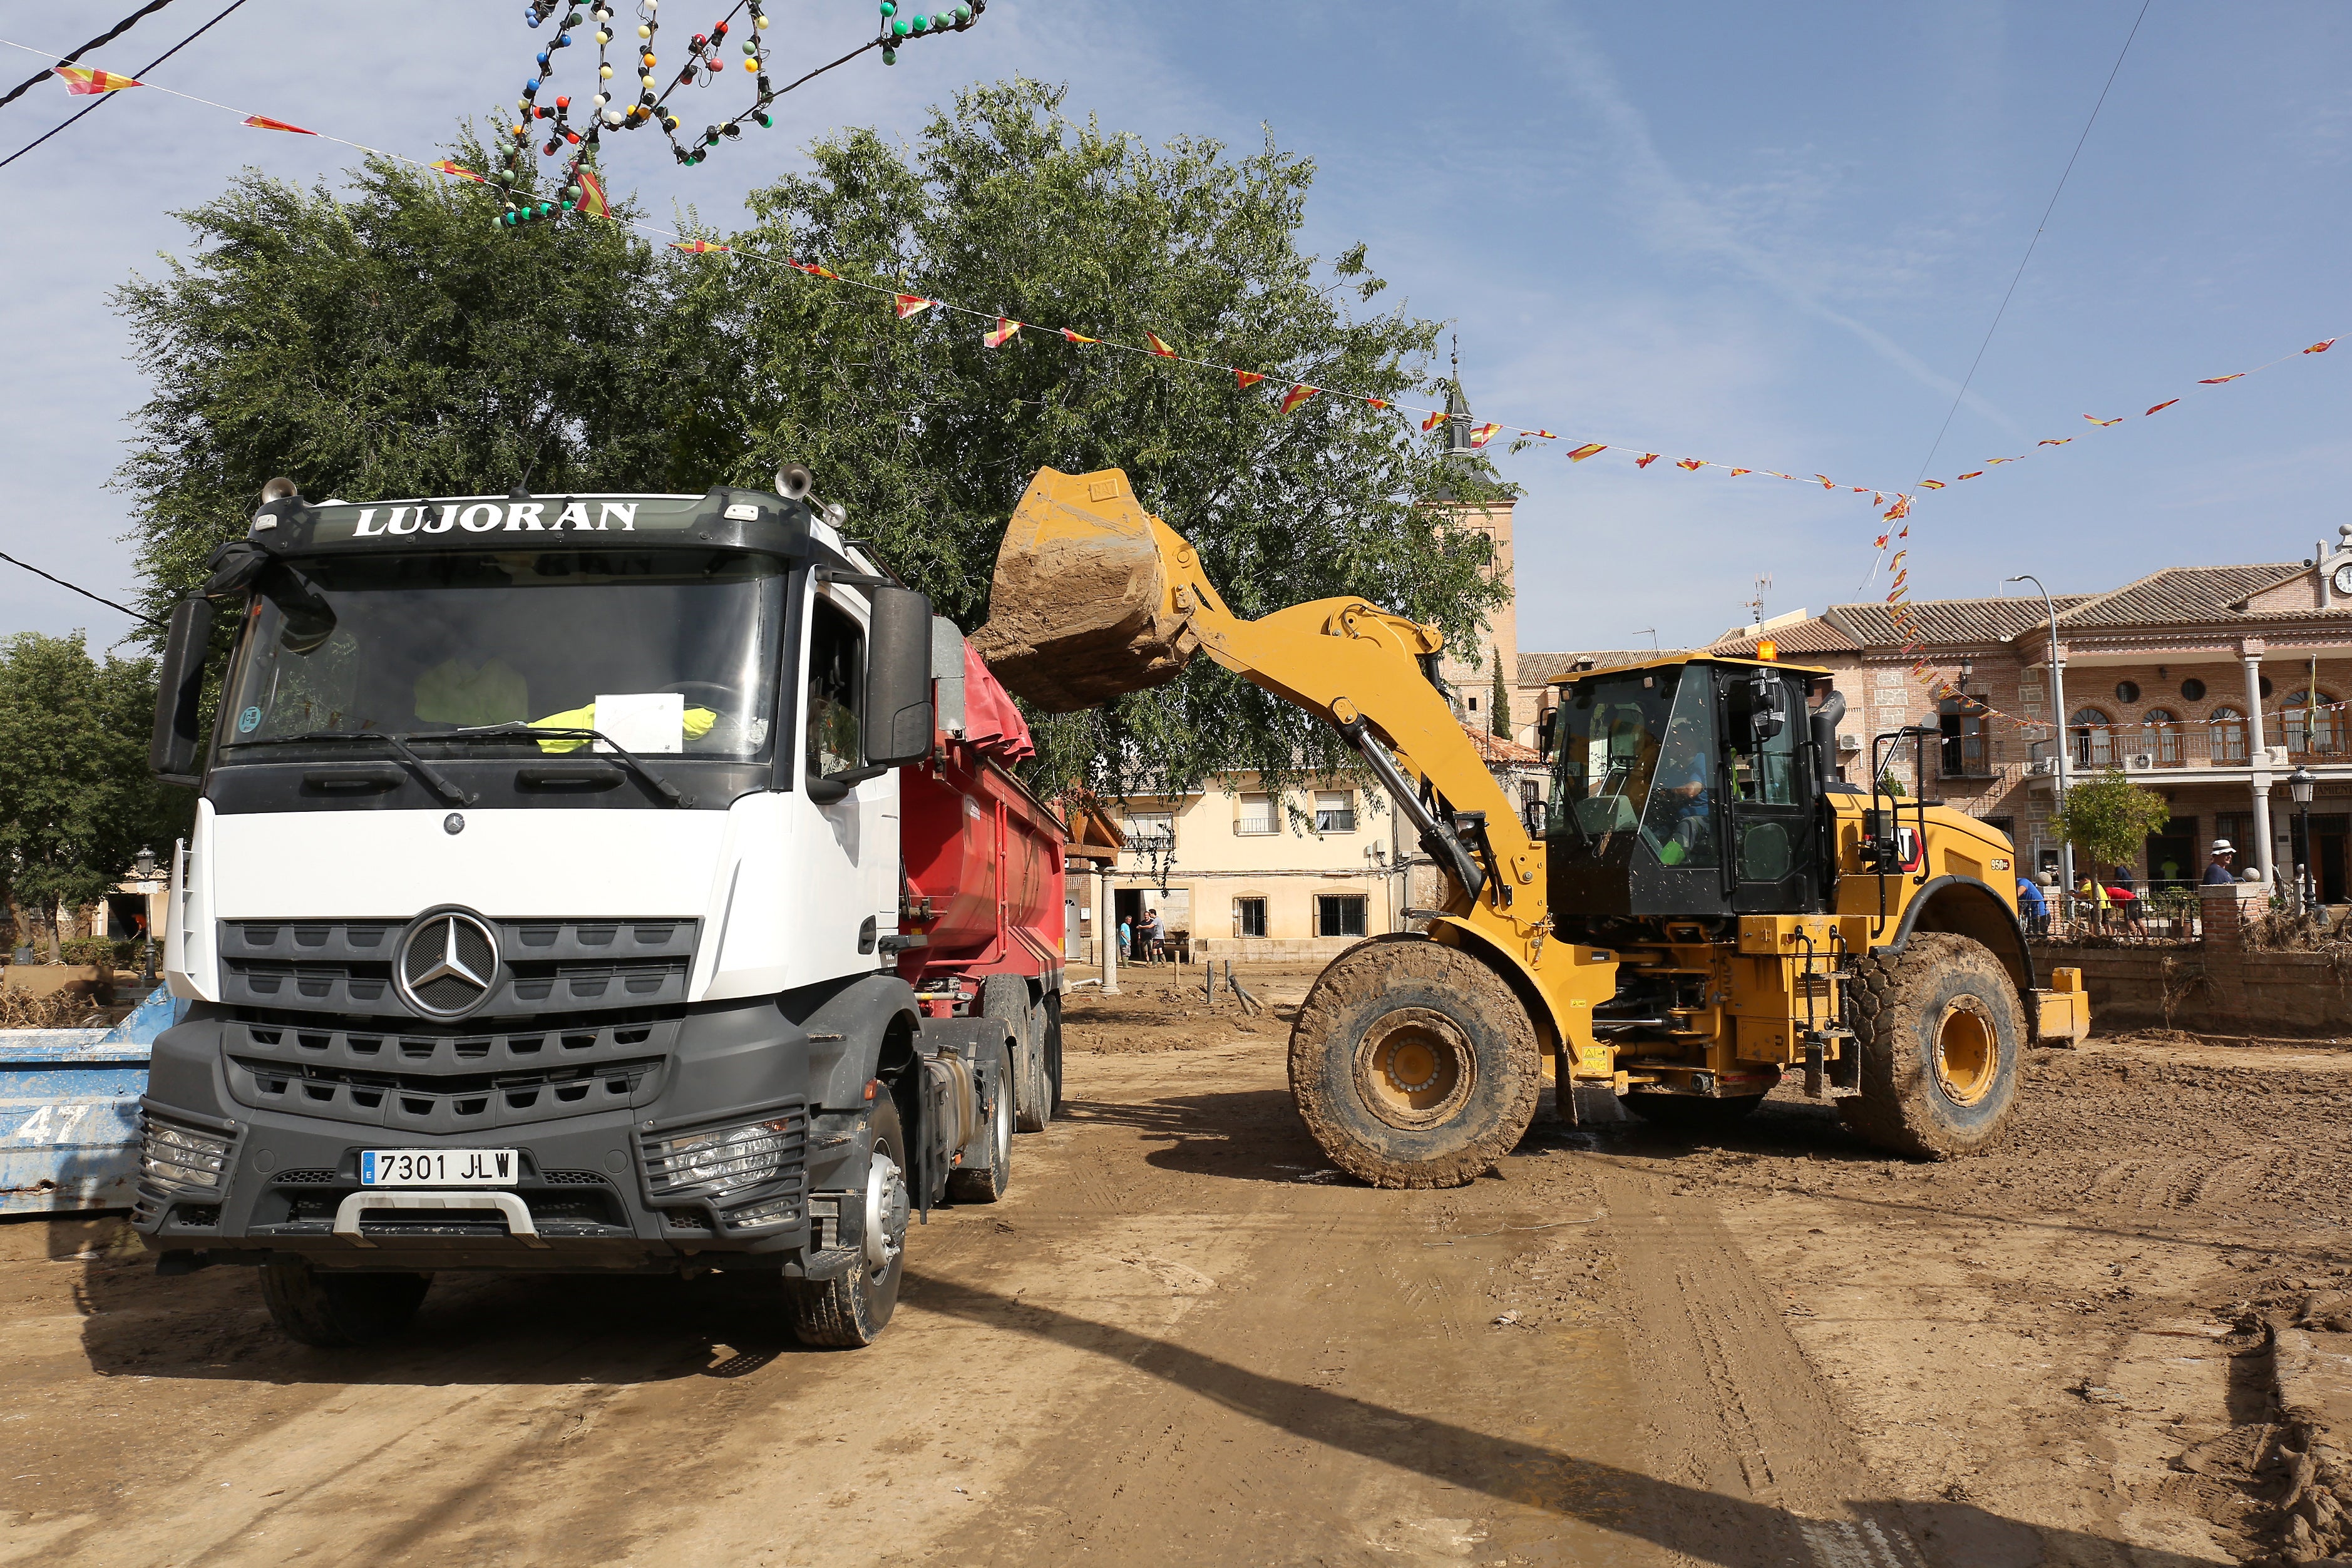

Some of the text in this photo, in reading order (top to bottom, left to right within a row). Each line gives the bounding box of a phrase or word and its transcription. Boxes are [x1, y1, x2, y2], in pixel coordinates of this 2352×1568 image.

[1092, 482, 1114, 497] CAT
[352, 503, 639, 537] LUJORAN
[16, 1105, 90, 1144] 47
[381, 1155, 444, 1181] 7301
[461, 1153, 510, 1179] JLW
